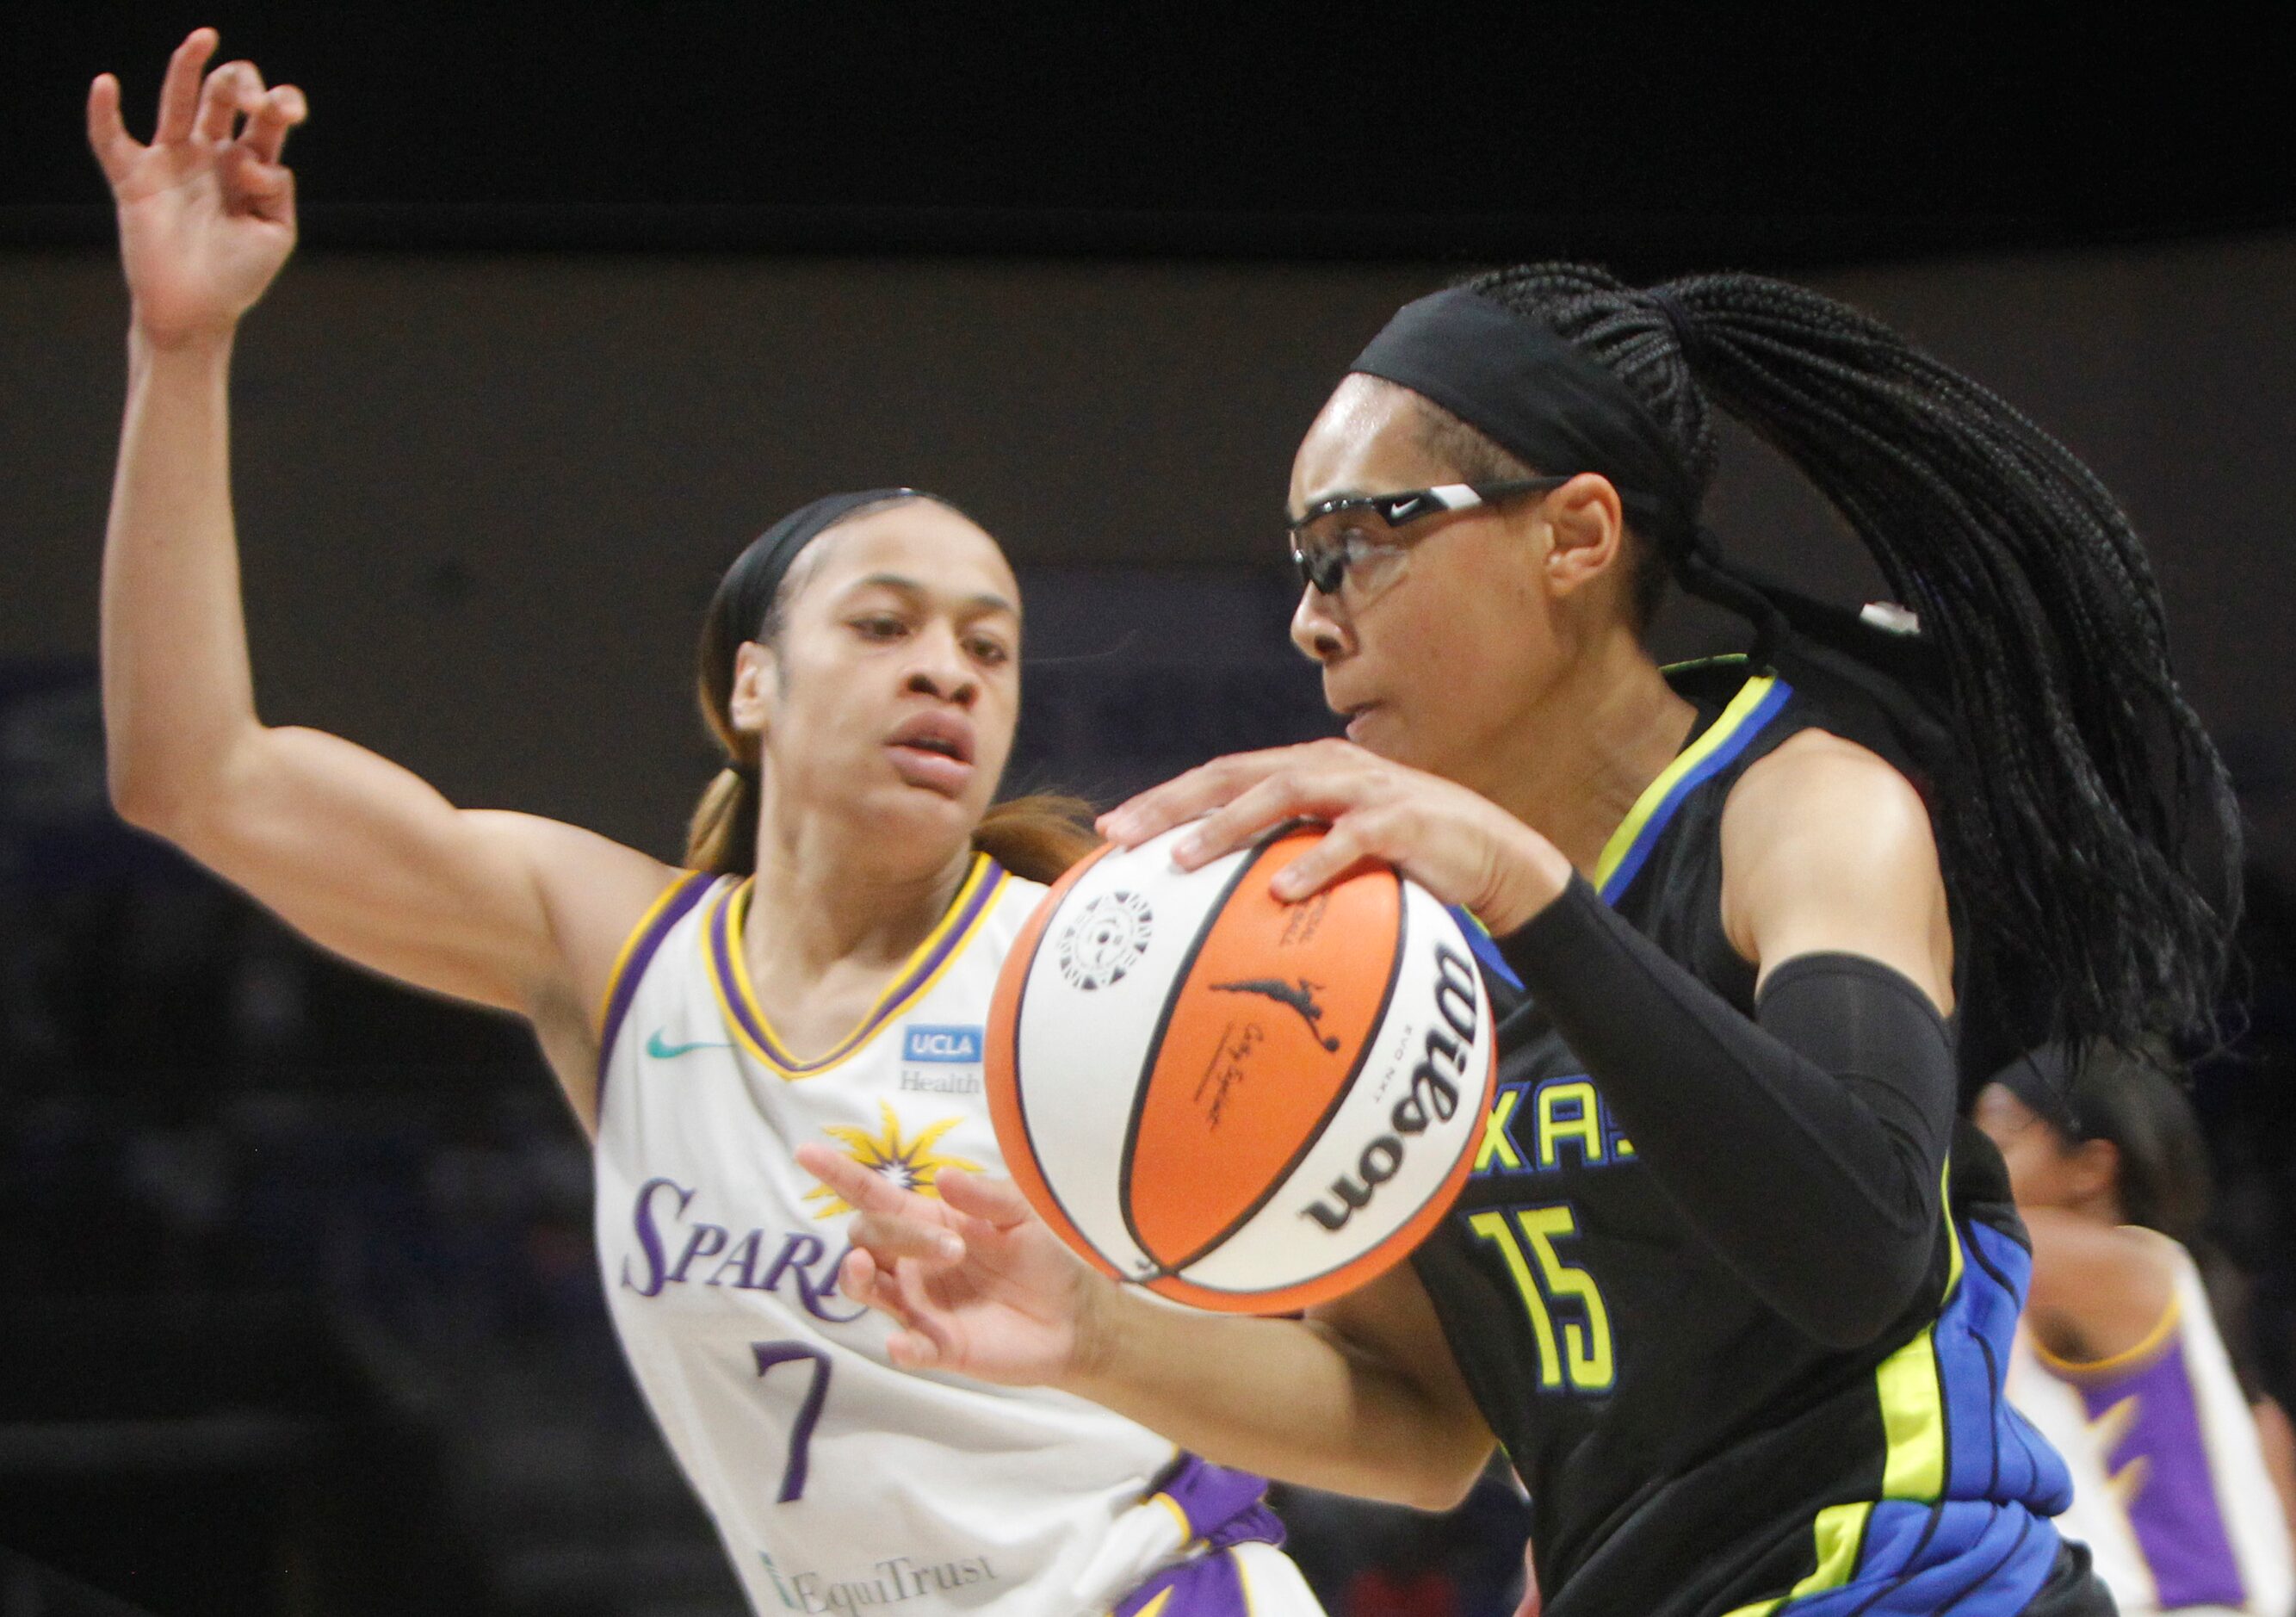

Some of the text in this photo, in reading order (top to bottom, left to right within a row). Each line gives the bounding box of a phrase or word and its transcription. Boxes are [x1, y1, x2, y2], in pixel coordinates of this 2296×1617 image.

[900, 1069, 981, 1094] Health
[911, 1032, 974, 1056] UCLA
[1469, 1074, 1636, 1178] XA
[1463, 1203, 1616, 1391] 15
[751, 1340, 832, 1503] 7
[791, 1554, 998, 1617] EquiTrust
